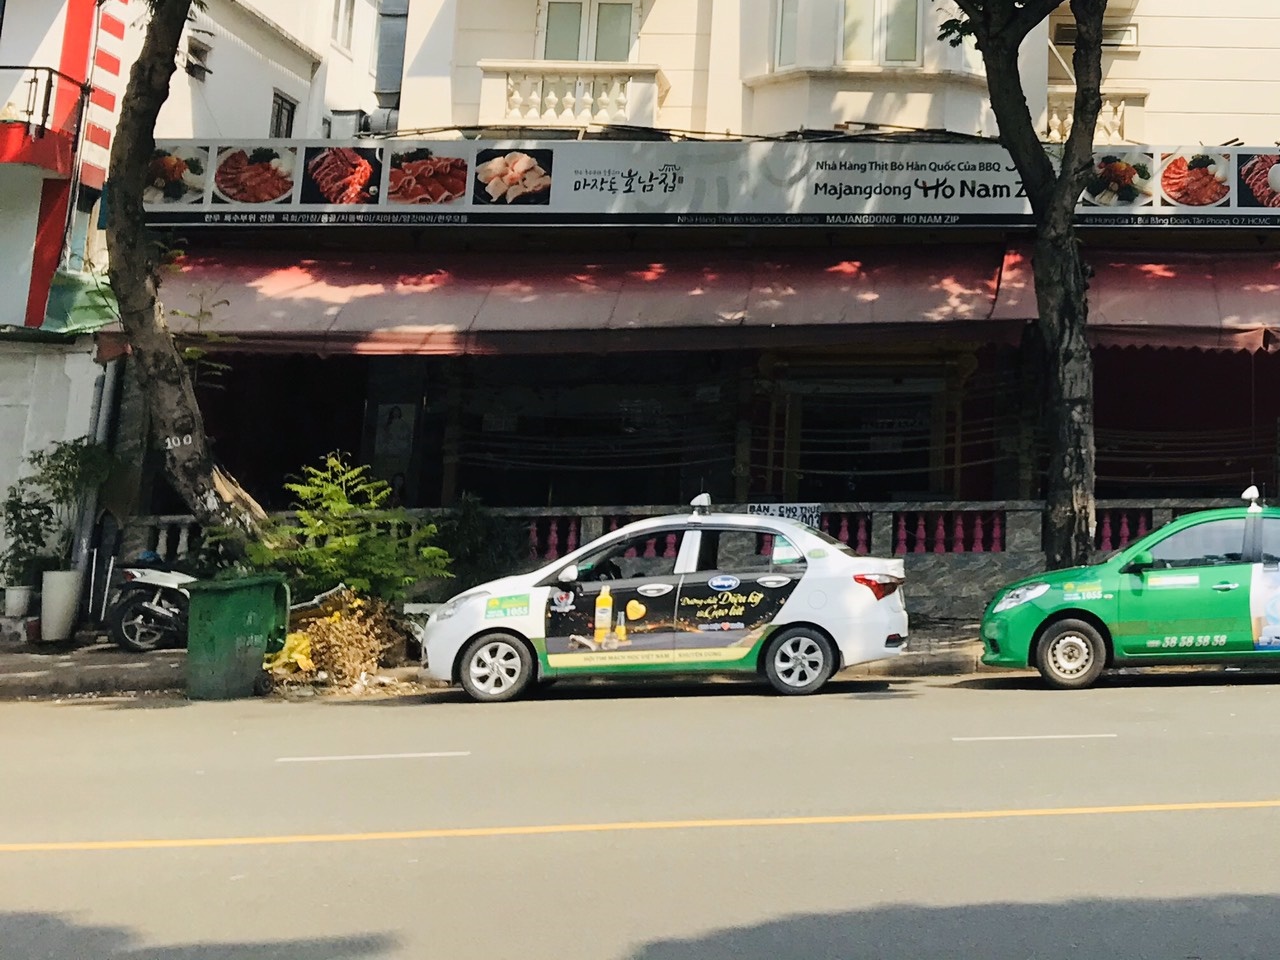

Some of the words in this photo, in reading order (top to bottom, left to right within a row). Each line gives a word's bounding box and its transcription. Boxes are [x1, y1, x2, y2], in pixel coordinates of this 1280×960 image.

[816, 161, 836, 171] Nhà
[839, 161, 866, 173] Hàng
[868, 161, 888, 173] Thịt
[928, 160, 956, 172] Quốc
[957, 160, 977, 172] Của
[978, 162, 1001, 172] BBQ
[814, 183, 912, 200] Majangdong
[959, 180, 1011, 198] Nam
[826, 215, 896, 224] MAJANGDONG
[903, 215, 917, 224] HO
[919, 215, 942, 224] NAM
[943, 215, 960, 224] ZIP
